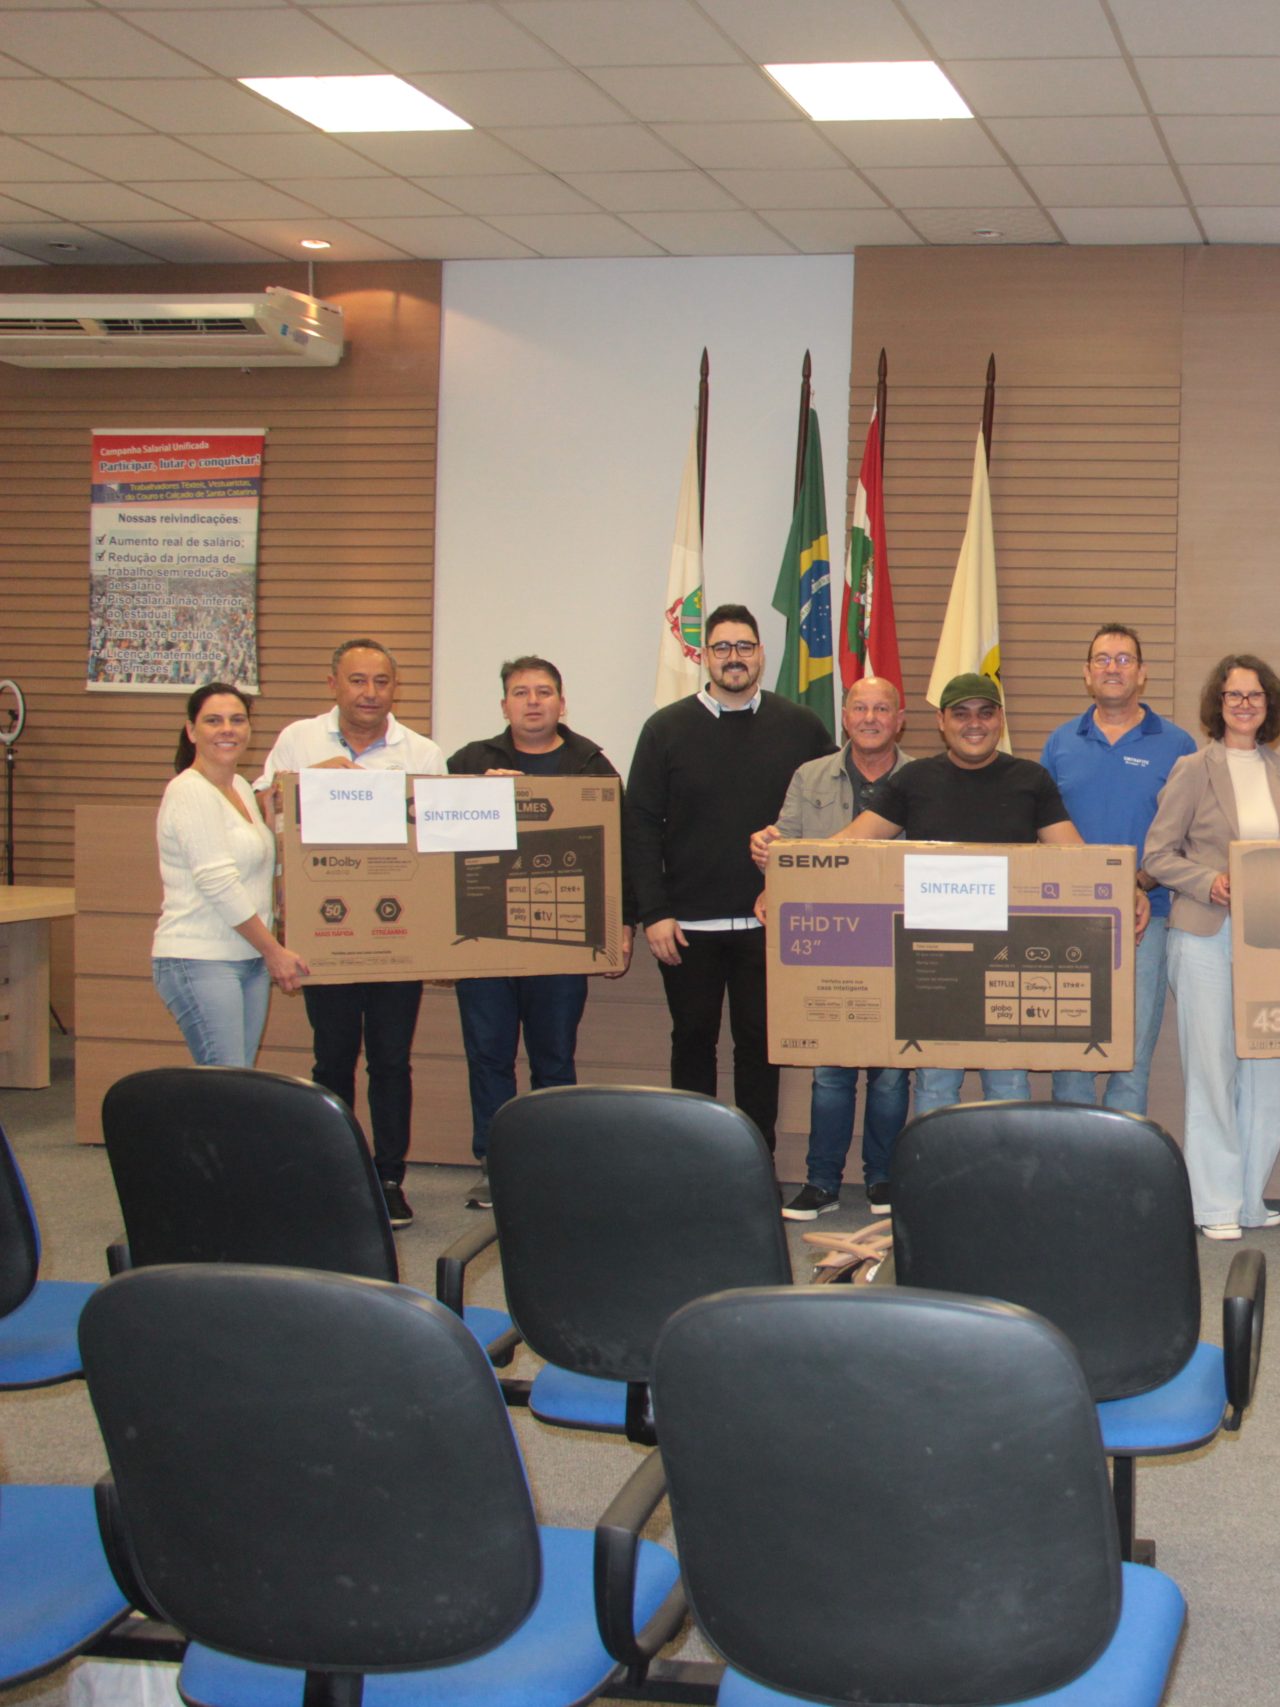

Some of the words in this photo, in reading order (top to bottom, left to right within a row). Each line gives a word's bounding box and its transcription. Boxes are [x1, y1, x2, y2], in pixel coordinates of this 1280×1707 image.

[100, 446, 142, 457] Campanha
[143, 443, 172, 454] Salarial
[173, 441, 209, 451] Unificada
[100, 460, 158, 473] Participar,
[159, 458, 185, 469] lutar
[188, 460, 197, 469] e
[199, 454, 262, 467] conquistar!
[118, 513, 157, 524] Nossas
[160, 513, 241, 526] reivindicações:
[108, 536, 159, 546] Aumento
[162, 536, 183, 547] real
[186, 537, 200, 547] de
[202, 537, 246, 549] salário;
[108, 552, 157, 564] Redução
[160, 553, 174, 563] da
[176, 553, 219, 565] jornada
[222, 553, 236, 564] de
[108, 567, 154, 577] trabalho
[157, 569, 180, 578] sem
[183, 567, 229, 579] redução
[108, 581, 122, 591] de
[108, 628, 167, 640] Transporte
[329, 789, 374, 801] SINSEB
[516, 802, 547, 813] LMES
[424, 809, 500, 822] SINTRICOMB
[328, 856, 361, 869] Dolby
[778, 854, 850, 868] SEMP
[920, 881, 996, 896] SINTRAFITE
[789, 915, 830, 932] FHD
[834, 917, 860, 933] TV
[989, 980, 1015, 989] NETFLIX
[990, 1004, 1012, 1014] globo
[1036, 1006, 1050, 1019] tv
[996, 1011, 1014, 1021] play
